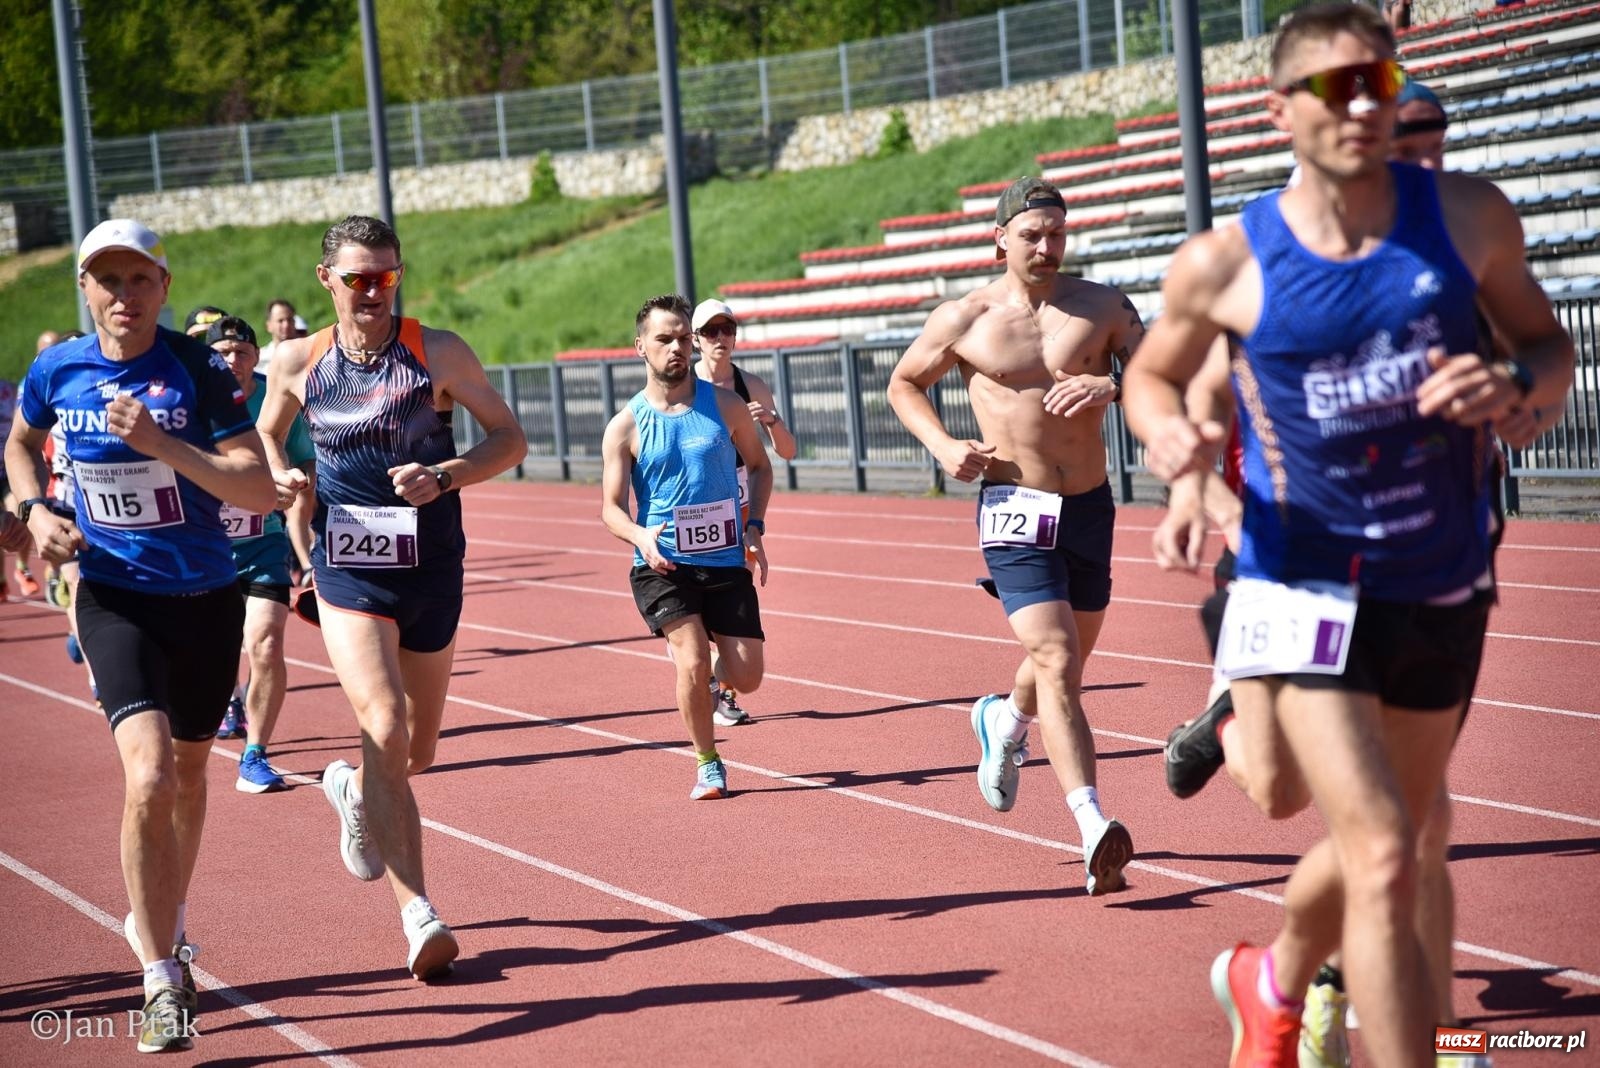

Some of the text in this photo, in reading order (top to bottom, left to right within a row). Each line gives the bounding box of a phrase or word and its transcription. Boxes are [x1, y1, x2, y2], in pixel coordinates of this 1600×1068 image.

[55, 408, 188, 433] RUNRS
[94, 468, 109, 476] BIEG
[110, 468, 122, 476] BEZ
[124, 466, 150, 476] GRANIC
[98, 493, 142, 517] 115
[374, 511, 397, 519] GRANIC
[685, 523, 720, 545] 158
[992, 513, 1027, 536] 172
[338, 533, 391, 557] 242
